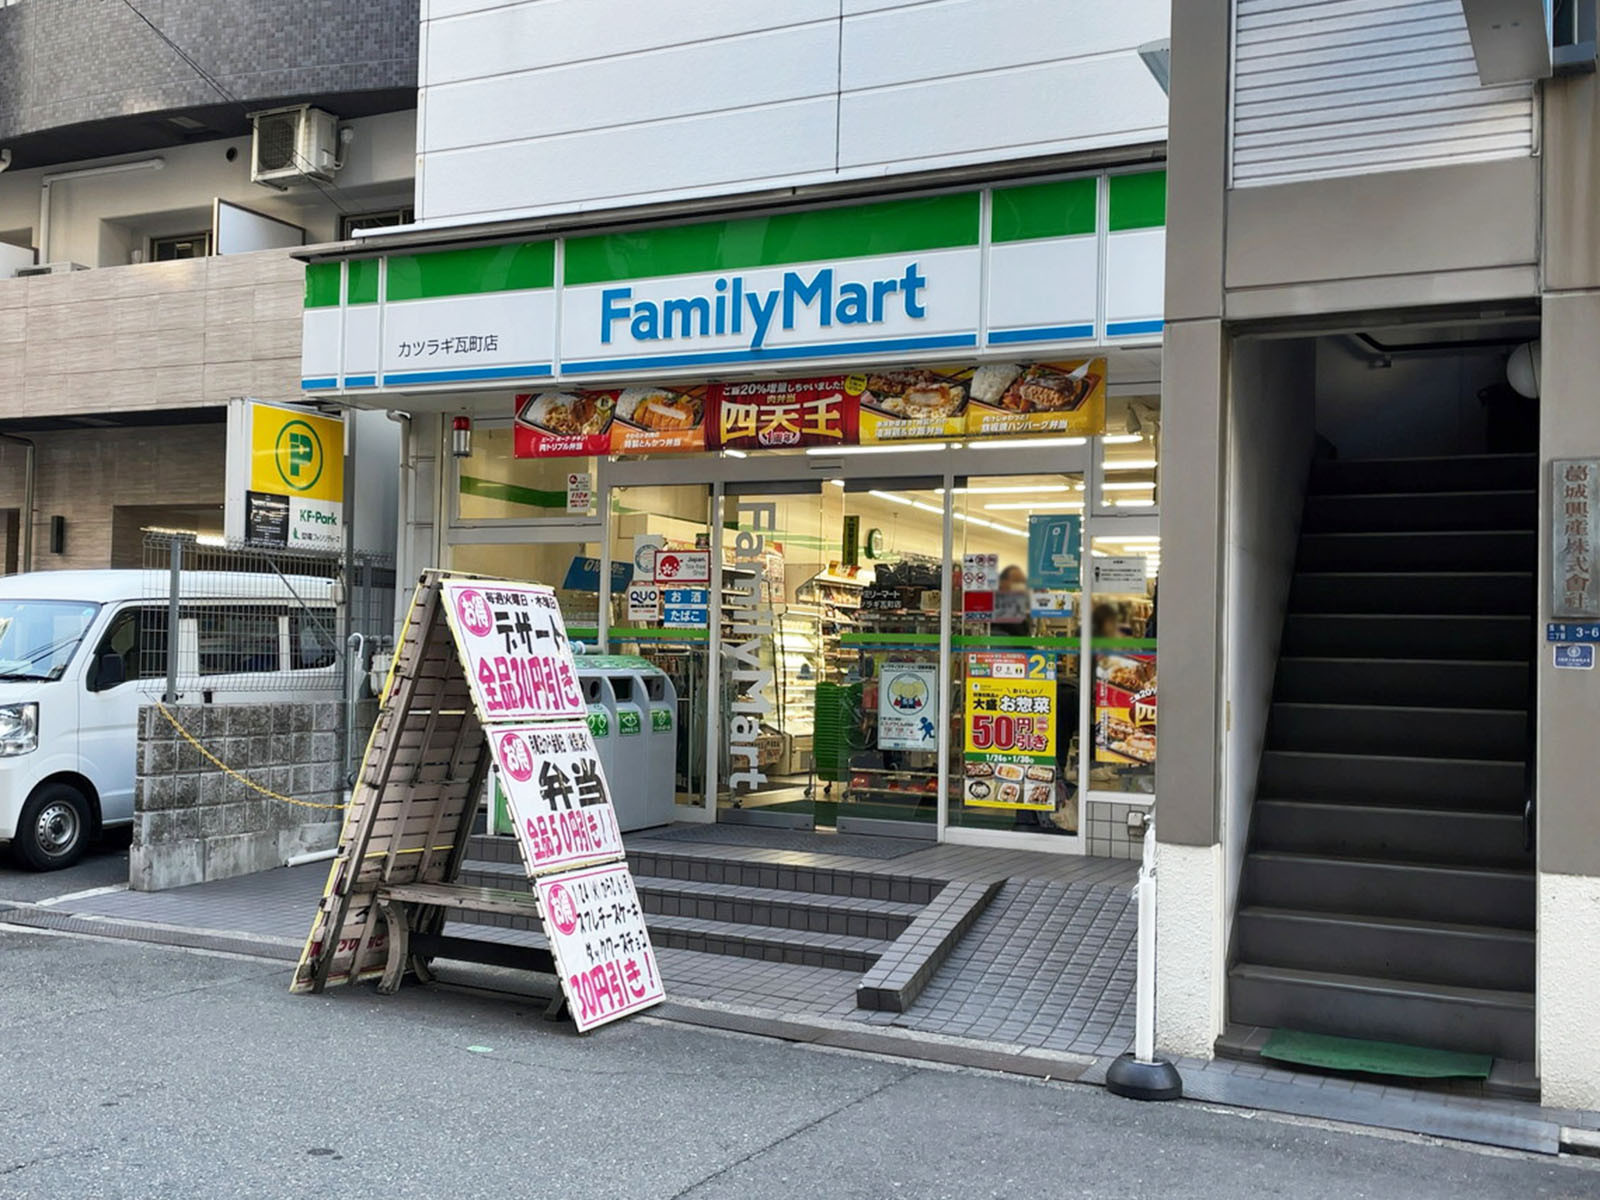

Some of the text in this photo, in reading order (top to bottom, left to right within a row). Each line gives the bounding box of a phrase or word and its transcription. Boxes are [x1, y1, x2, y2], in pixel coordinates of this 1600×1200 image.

[600, 262, 927, 349] FamilyMart
[397, 334, 499, 358] カツラギ瓦町店
[720, 392, 844, 445] 四天王
[289, 432, 313, 477] P
[299, 508, 338, 526] KF-Park
[630, 590, 657, 604] QUO
[670, 610, 701, 622] たばこ
[722, 502, 777, 791] FamilyMart
[1575, 626, 1600, 638] 3-6
[477, 655, 581, 711] 全品30円引き
[999, 694, 1051, 714] お惣菜
[538, 758, 608, 811] 弁当
[569, 951, 656, 1020] 30円引き!
